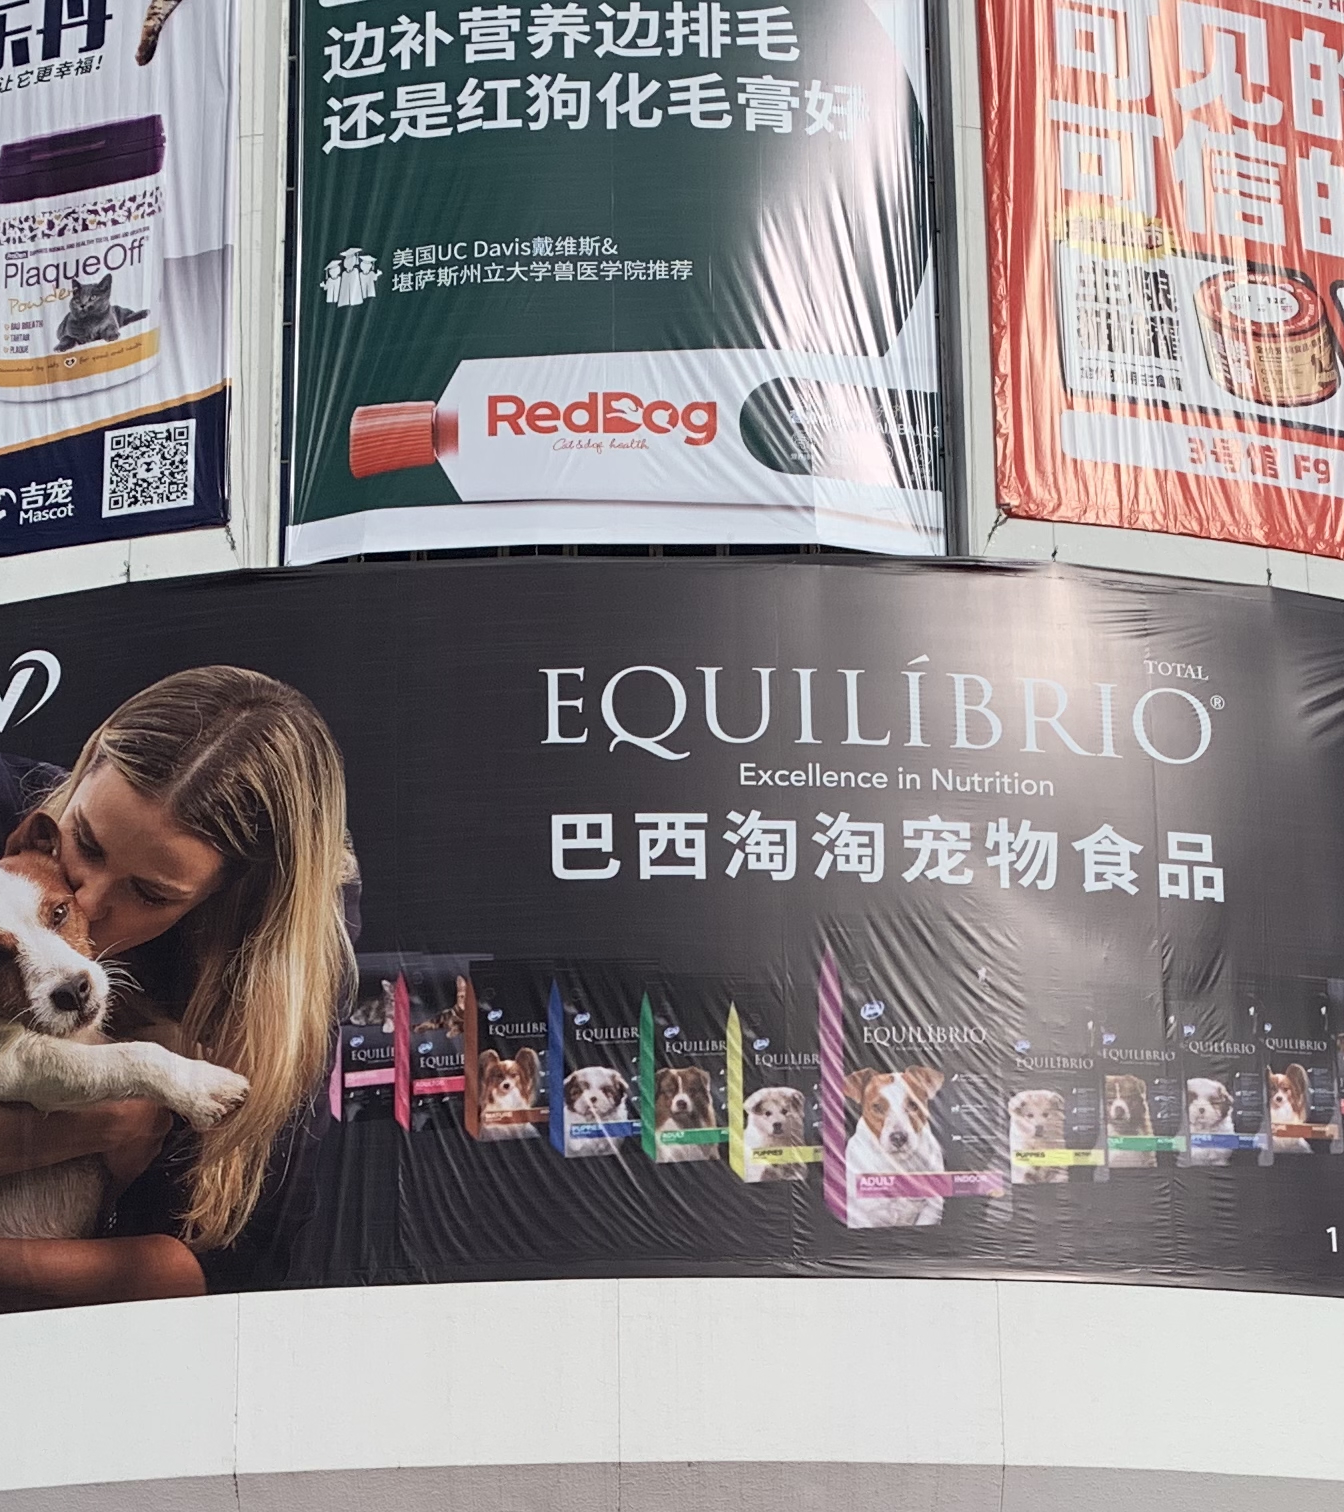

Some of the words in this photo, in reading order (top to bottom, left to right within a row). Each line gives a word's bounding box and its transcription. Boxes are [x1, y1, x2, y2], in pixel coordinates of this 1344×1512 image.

[322, 1, 800, 84] 边补营养边排毛
[322, 72, 869, 154] 还是红狗化毛膏好
[5, 239, 145, 289] PlaqueOff
[393, 243, 467, 268] 美国UC
[474, 236, 618, 259] Davis戴维斯&
[392, 259, 693, 293] 堪萨斯州立大学兽医学院推荐
[9, 286, 72, 314] Powder
[487, 391, 717, 447] RedDog
[1294, 453, 1331, 484] F9
[20, 479, 73, 506] 吉宠
[20, 504, 74, 526] Mascot
[1144, 660, 1209, 681] TOTAL
[539, 654, 1212, 764] EQUILÍBRIO
[740, 763, 889, 790] Excellence
[897, 767, 922, 791] in
[932, 768, 1055, 796] Nutrition
[551, 809, 1225, 903] 巴西淘淘宠物食品
[859, 1176, 896, 1187] ADULT
[1326, 1227, 1339, 1253] 1
